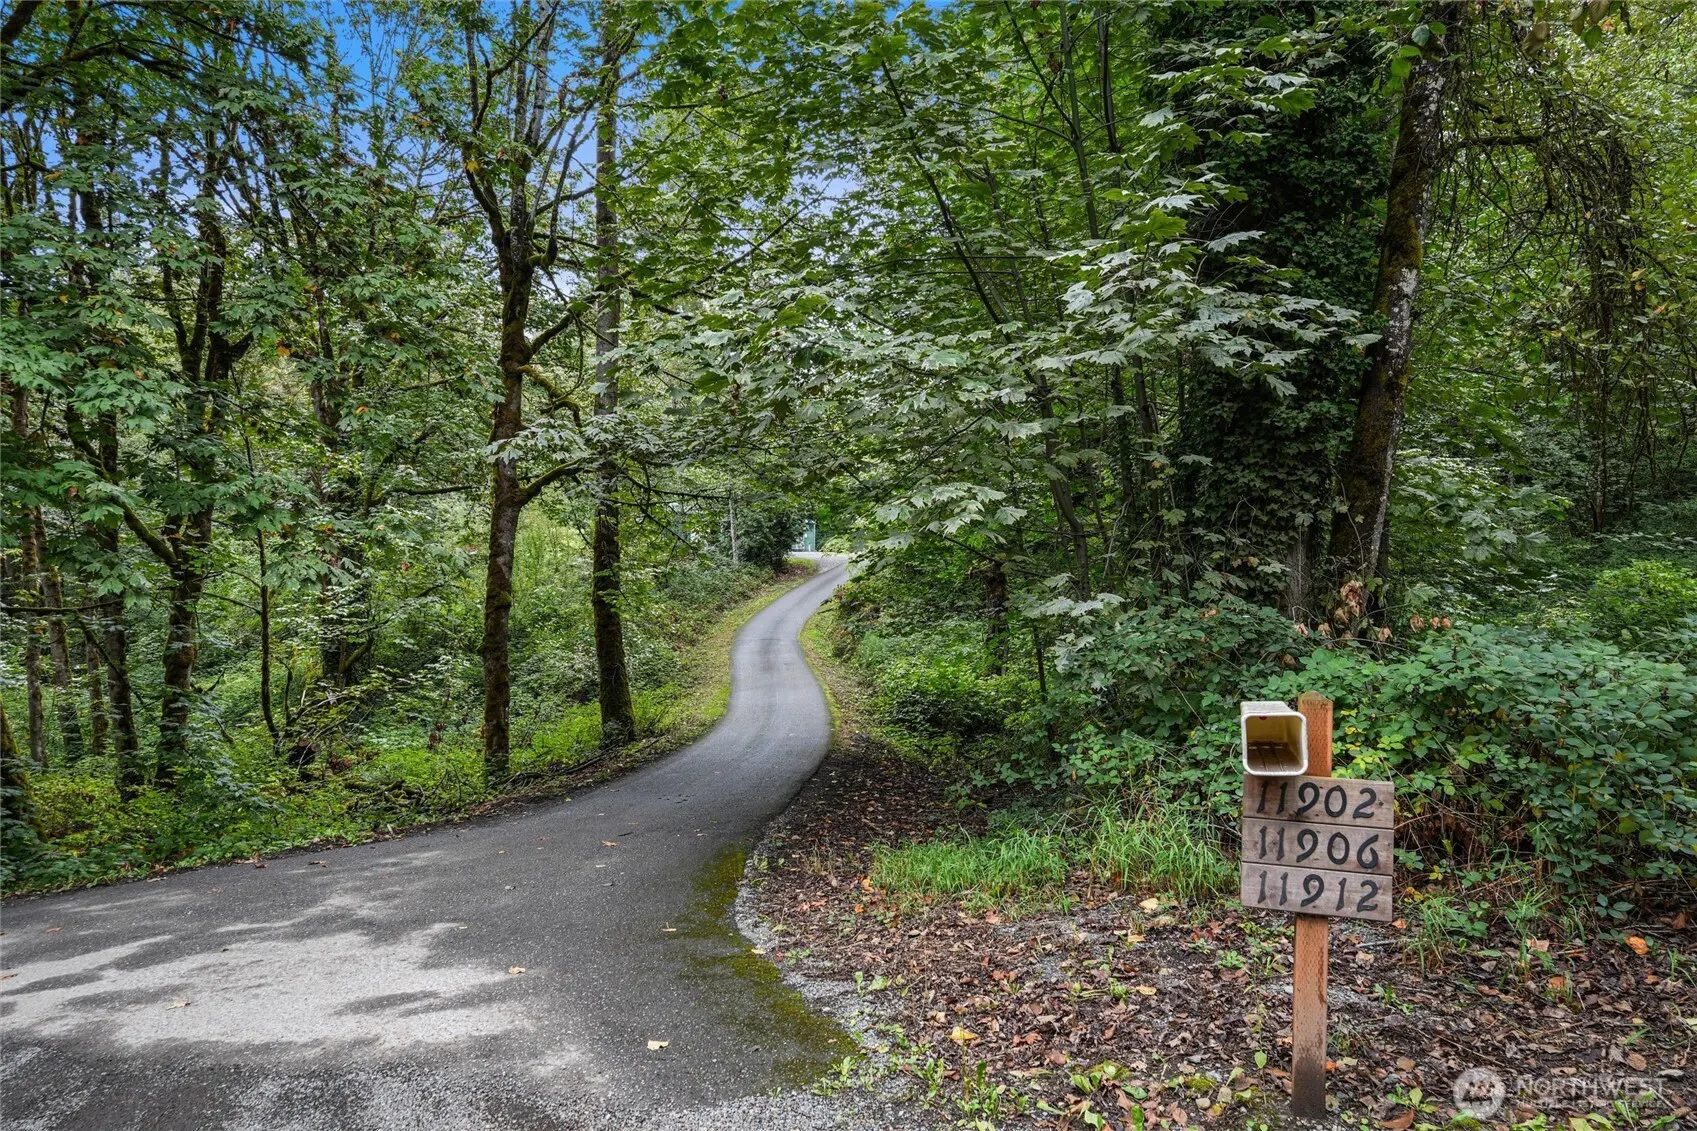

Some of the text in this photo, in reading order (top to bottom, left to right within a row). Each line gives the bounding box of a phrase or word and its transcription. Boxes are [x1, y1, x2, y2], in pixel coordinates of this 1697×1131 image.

[1257, 782, 1377, 819] 11902
[1259, 825, 1379, 869] 11906
[1258, 870, 1378, 912] 11912
